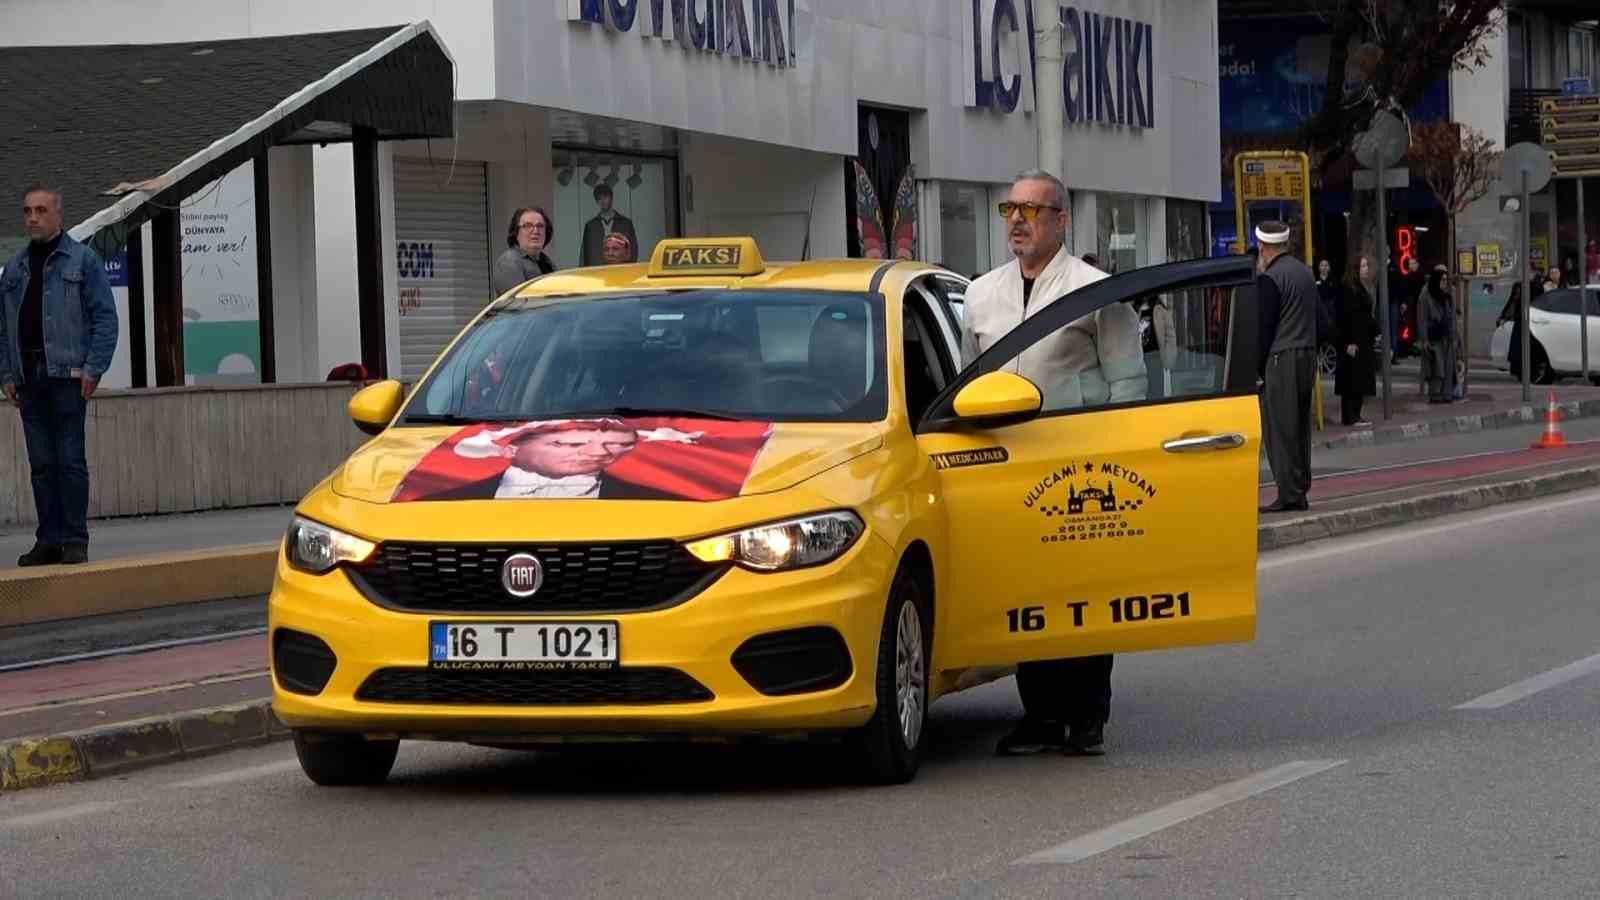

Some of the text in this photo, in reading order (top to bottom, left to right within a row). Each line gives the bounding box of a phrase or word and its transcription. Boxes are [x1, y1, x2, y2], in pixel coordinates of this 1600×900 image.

[184, 225, 225, 235] DÜNYAYA
[1101, 462, 1156, 498] MEYDAN
[510, 566, 535, 585] FIAT
[1006, 592, 1190, 632] 16 T 1021
[449, 626, 609, 658] 16 T 1021
[502, 661, 565, 670] MEYDAN
